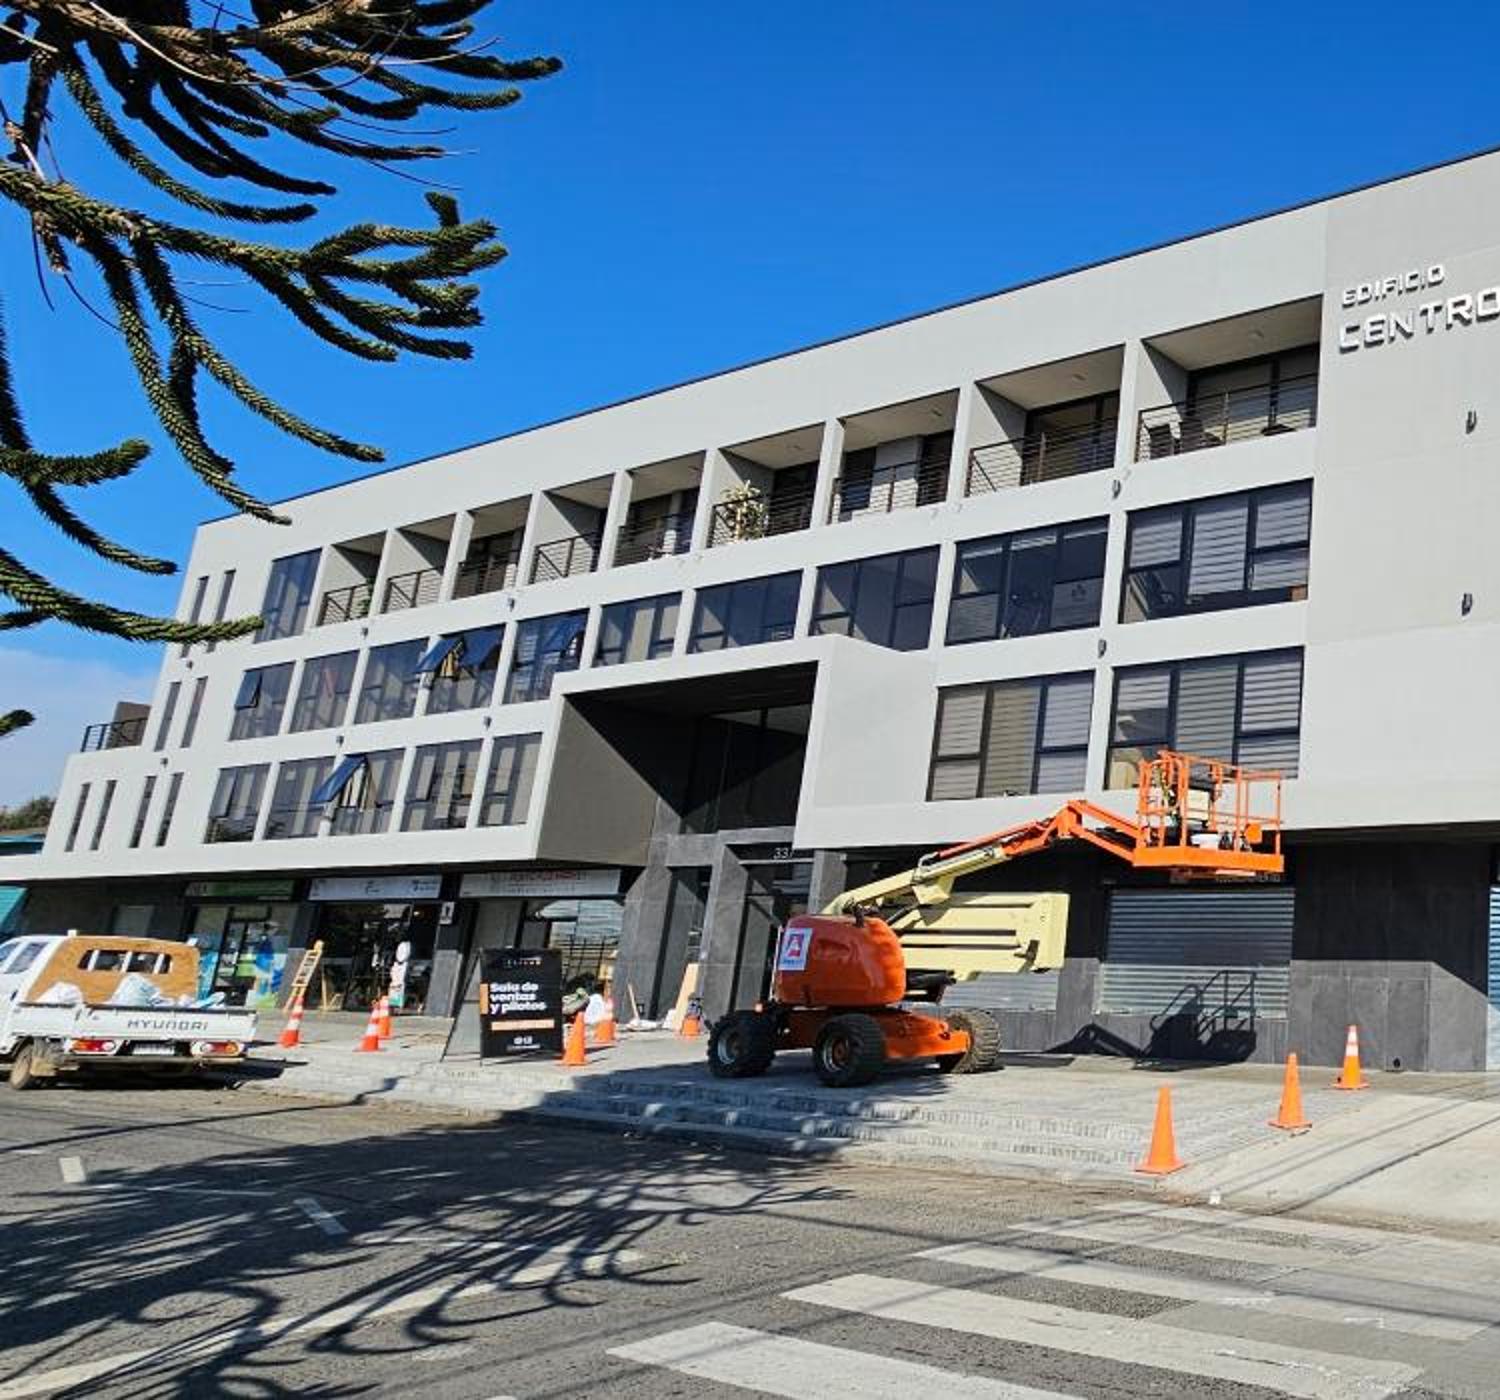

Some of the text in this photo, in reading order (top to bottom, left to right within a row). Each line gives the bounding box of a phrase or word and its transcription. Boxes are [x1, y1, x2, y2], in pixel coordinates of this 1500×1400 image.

[1342, 264, 1445, 309] EDIFICIO
[490, 982, 538, 992] Sala de
[490, 992, 536, 1002] ventas
[490, 1001, 547, 1014] y pilotos
[127, 1019, 208, 1031] HYUNDAI
